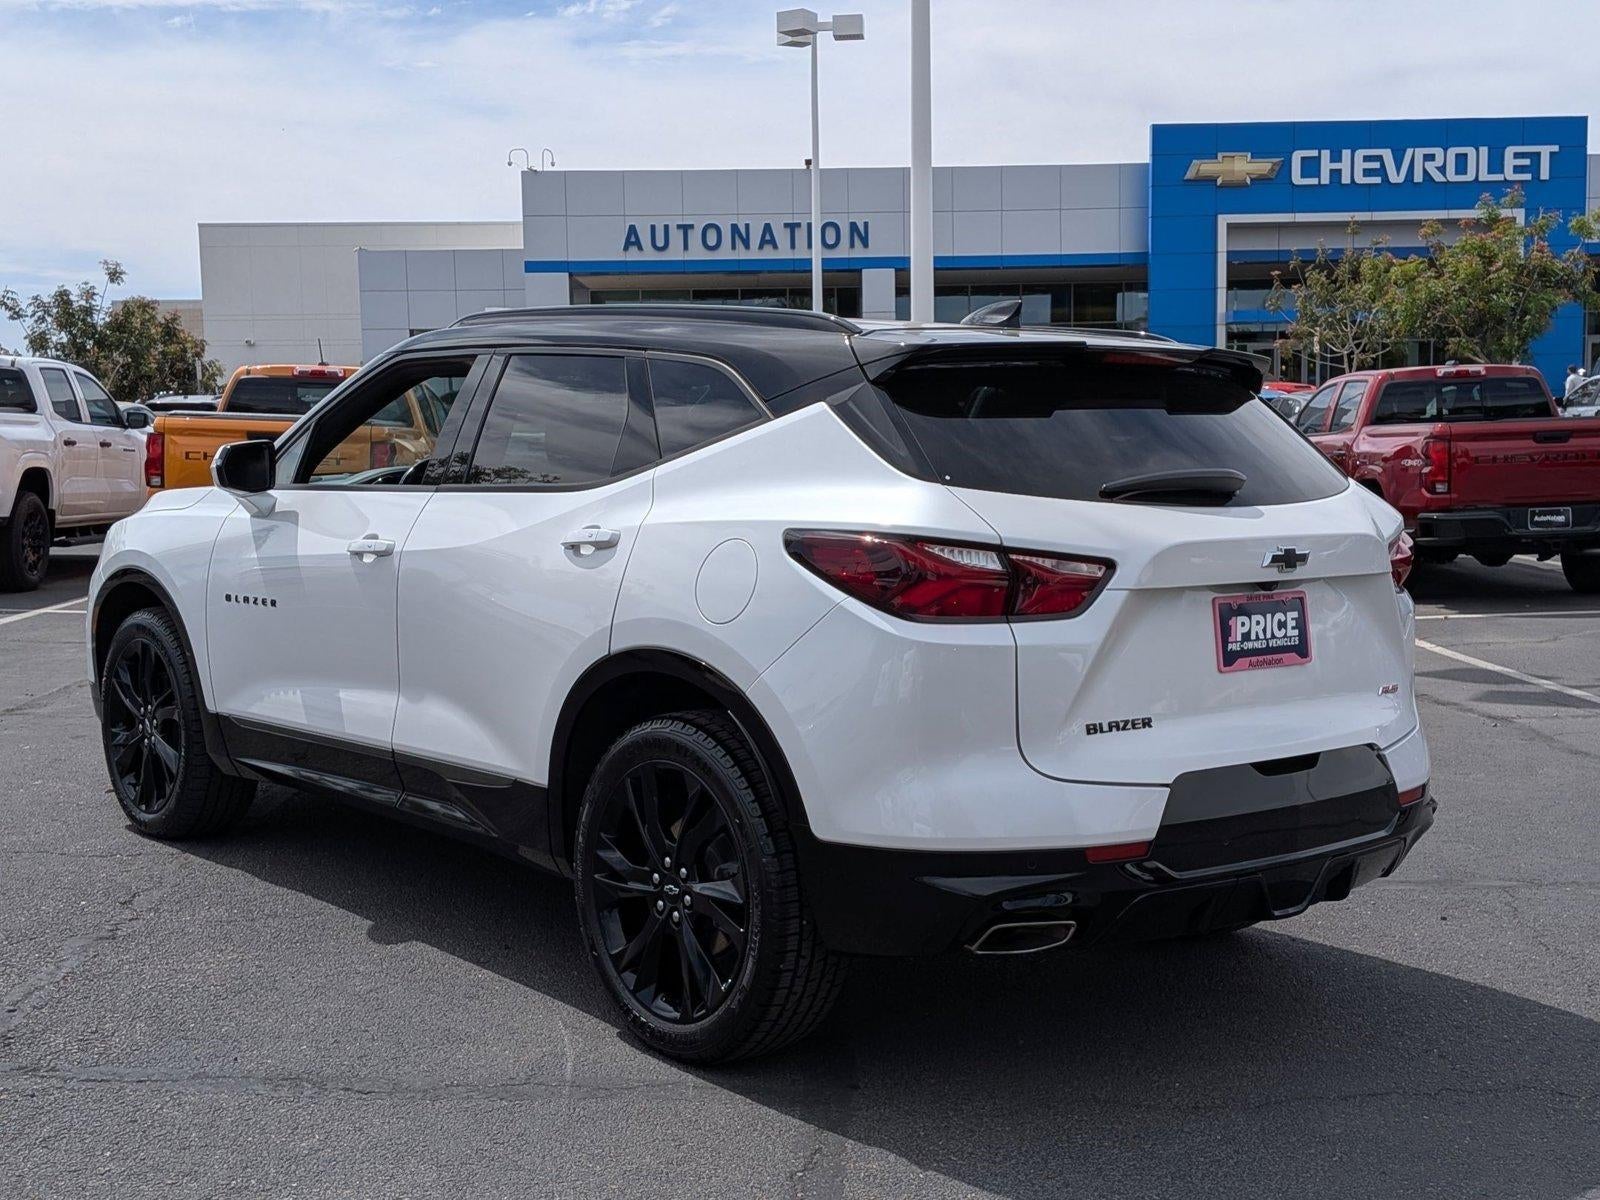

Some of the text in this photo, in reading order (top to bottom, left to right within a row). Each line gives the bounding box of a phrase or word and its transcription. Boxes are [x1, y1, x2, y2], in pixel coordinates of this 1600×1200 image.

[1290, 145, 1560, 186] CHEVROLET
[622, 221, 870, 252] AUTONATION
[225, 593, 277, 608] BLAZER
[1228, 637, 1299, 652] PRE-OWNED VEHICLES
[1248, 656, 1284, 669] AutoNation
[1085, 716, 1153, 735] BLAZER
